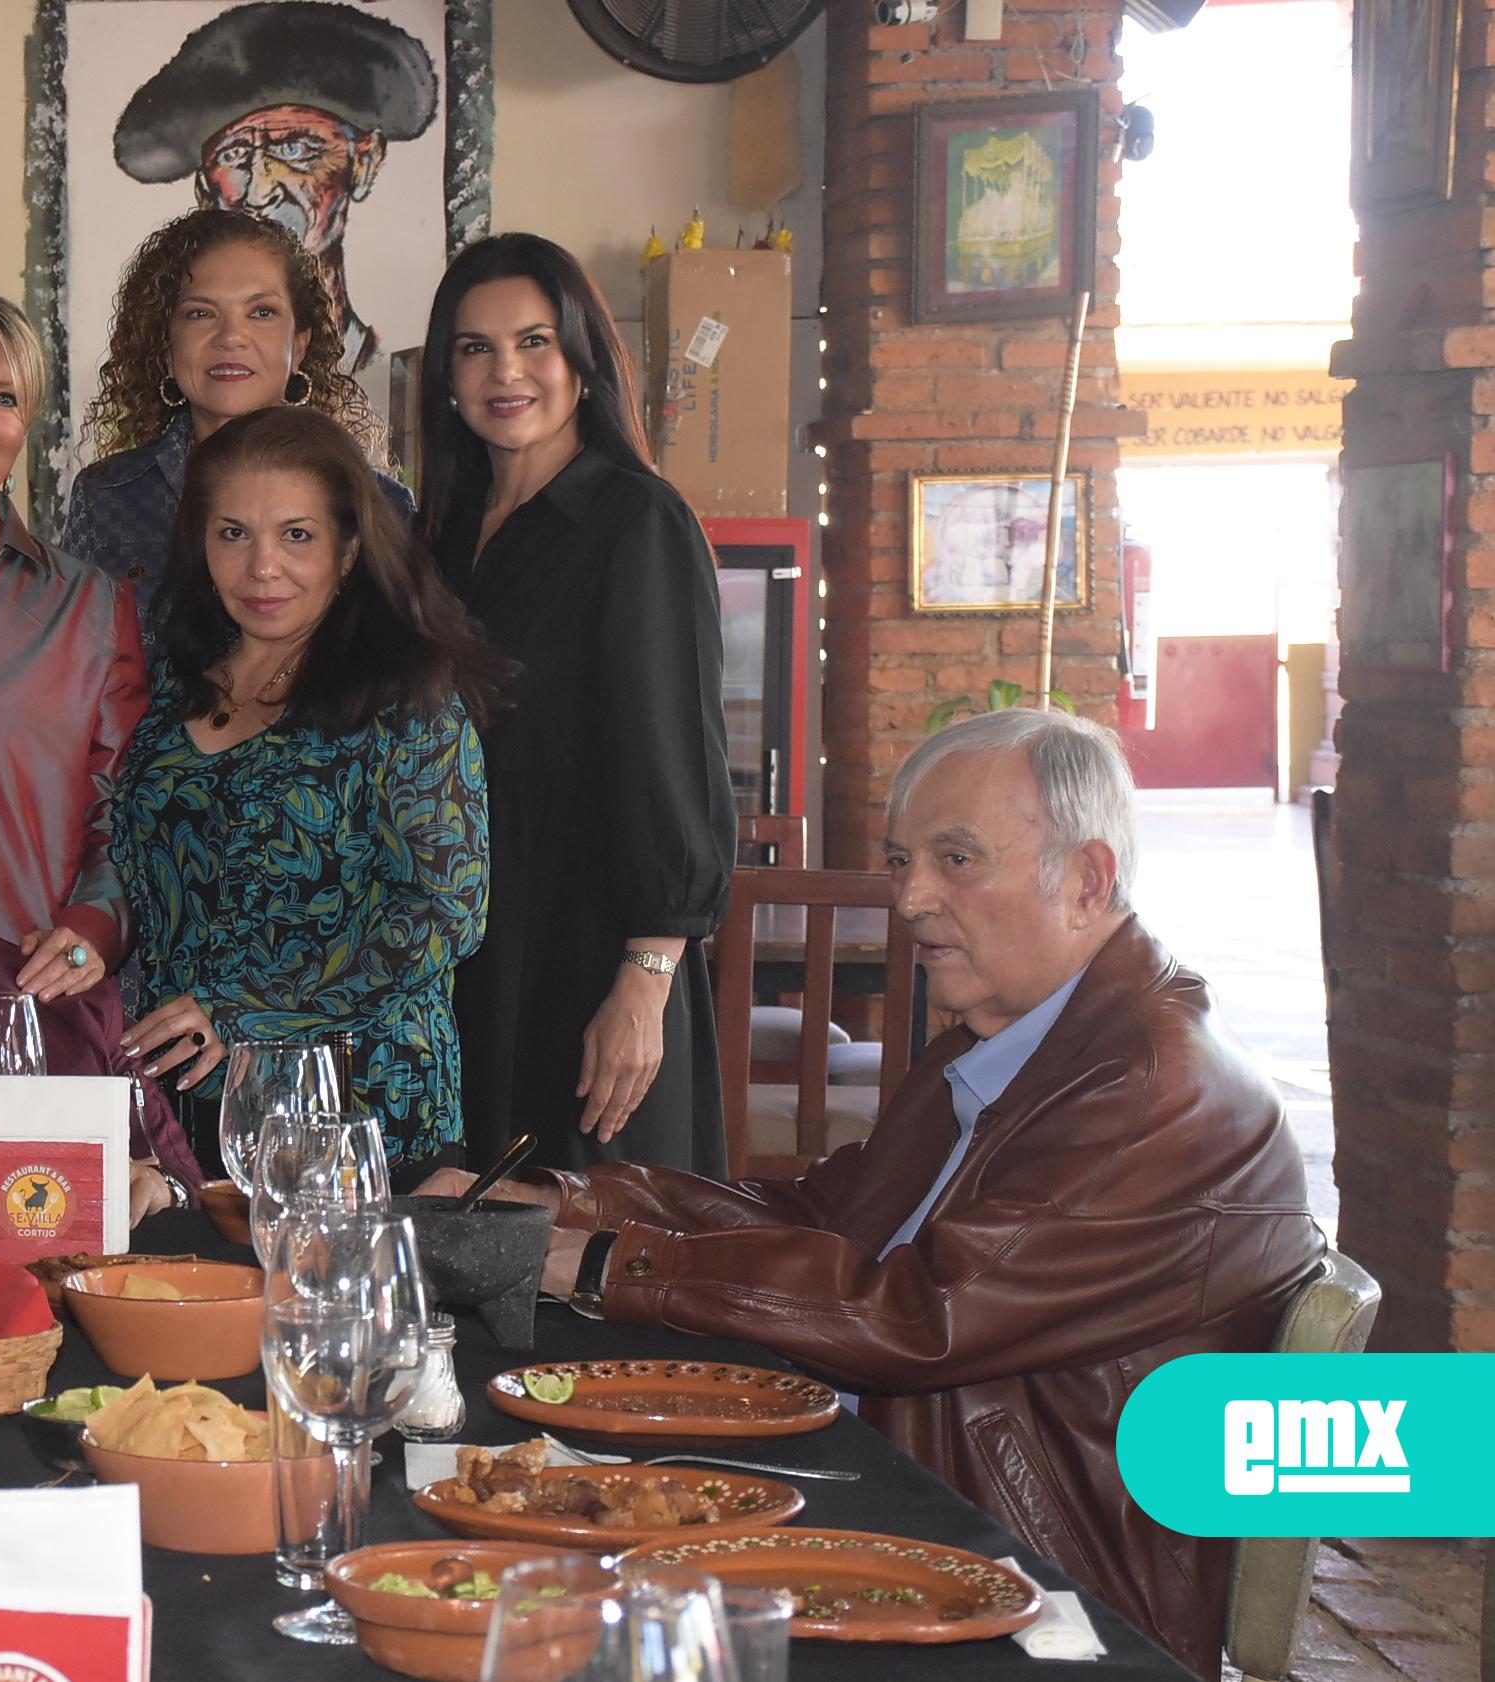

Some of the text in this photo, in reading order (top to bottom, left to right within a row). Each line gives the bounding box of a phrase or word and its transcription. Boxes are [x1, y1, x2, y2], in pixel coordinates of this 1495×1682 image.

[682, 363, 697, 411] LIFE
[1169, 390, 1255, 409] VALIENTE
[1265, 390, 1290, 407] NO
[1173, 426, 1251, 445] COBARDE
[1261, 427, 1285, 442] NO
[1, 1165, 51, 1192] RESTAURANT
[57, 1175, 72, 1193] BAR
[18, 1229, 56, 1238] CORTIJO
